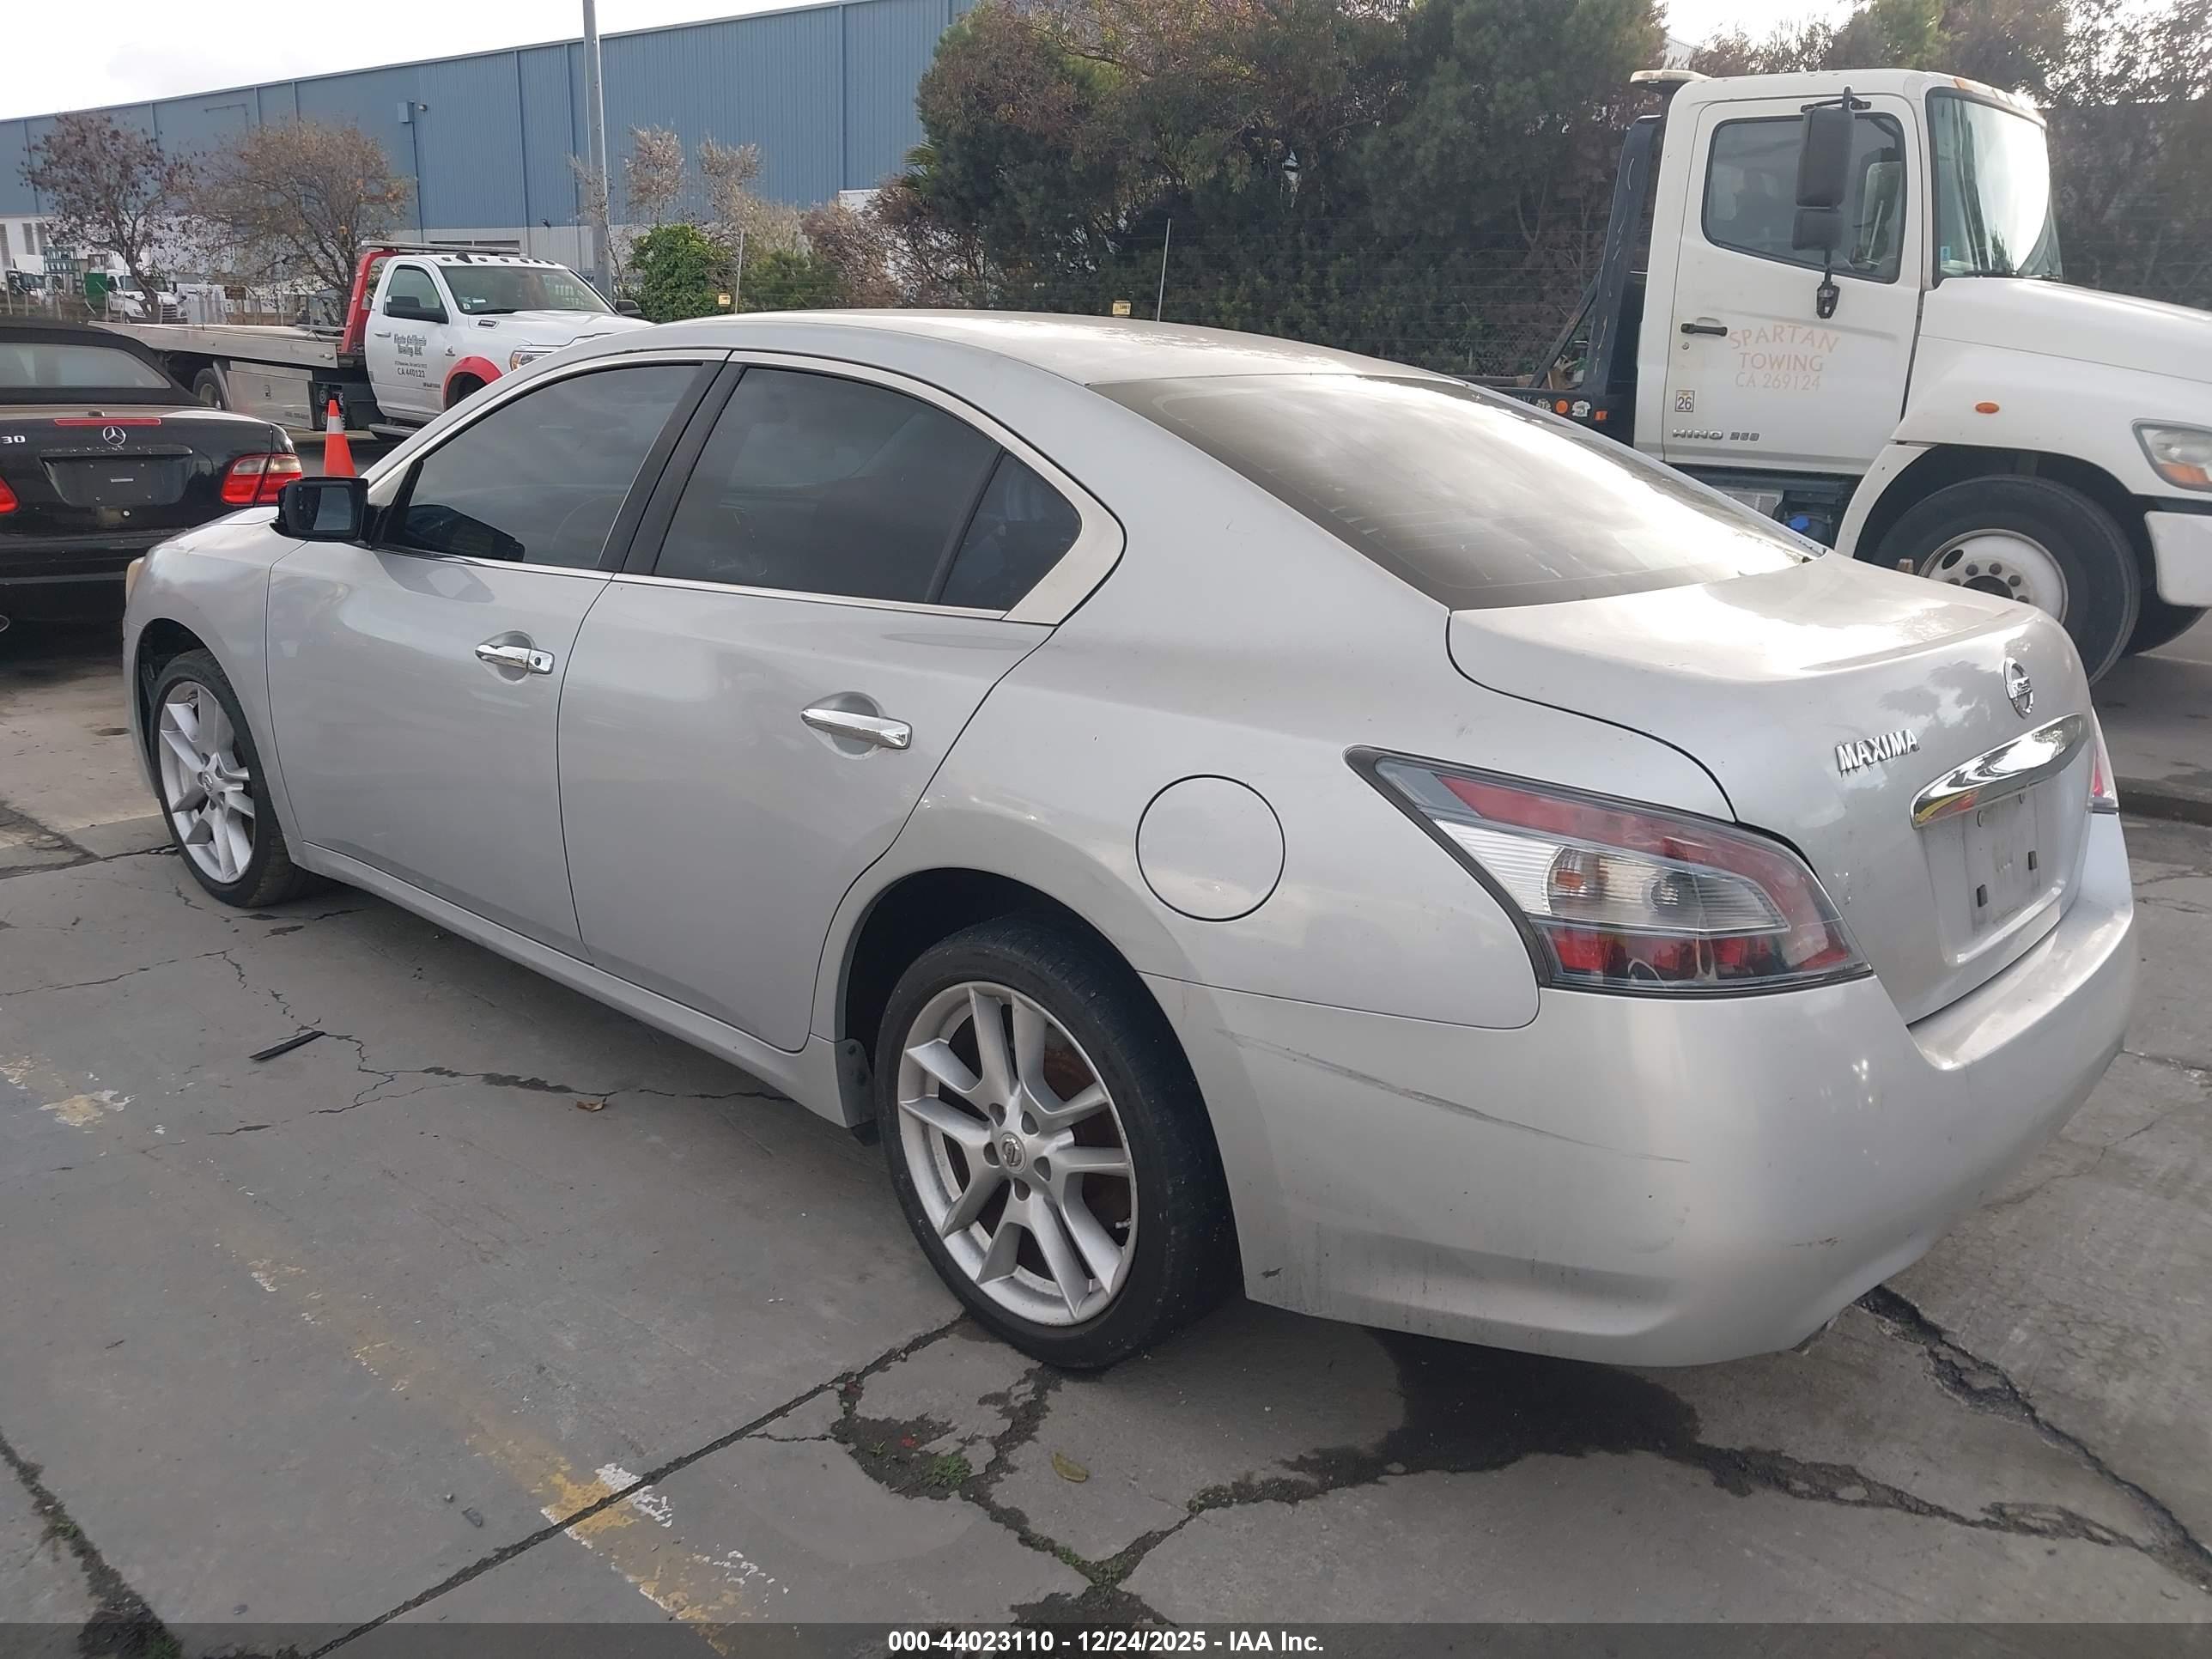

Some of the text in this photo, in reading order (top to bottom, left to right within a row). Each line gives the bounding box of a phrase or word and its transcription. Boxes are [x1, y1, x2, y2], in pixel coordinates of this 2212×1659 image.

[1729, 324, 1839, 353] SPARTAN
[1739, 351, 1825, 372] TOWING
[398, 368, 405, 376] CA
[1735, 372, 1821, 392] CA 269124
[1677, 396, 1692, 410] 26
[1, 434, 26, 444] 30
[1673, 428, 1723, 441] HINO
[1835, 729, 1920, 773] MAXIMA
